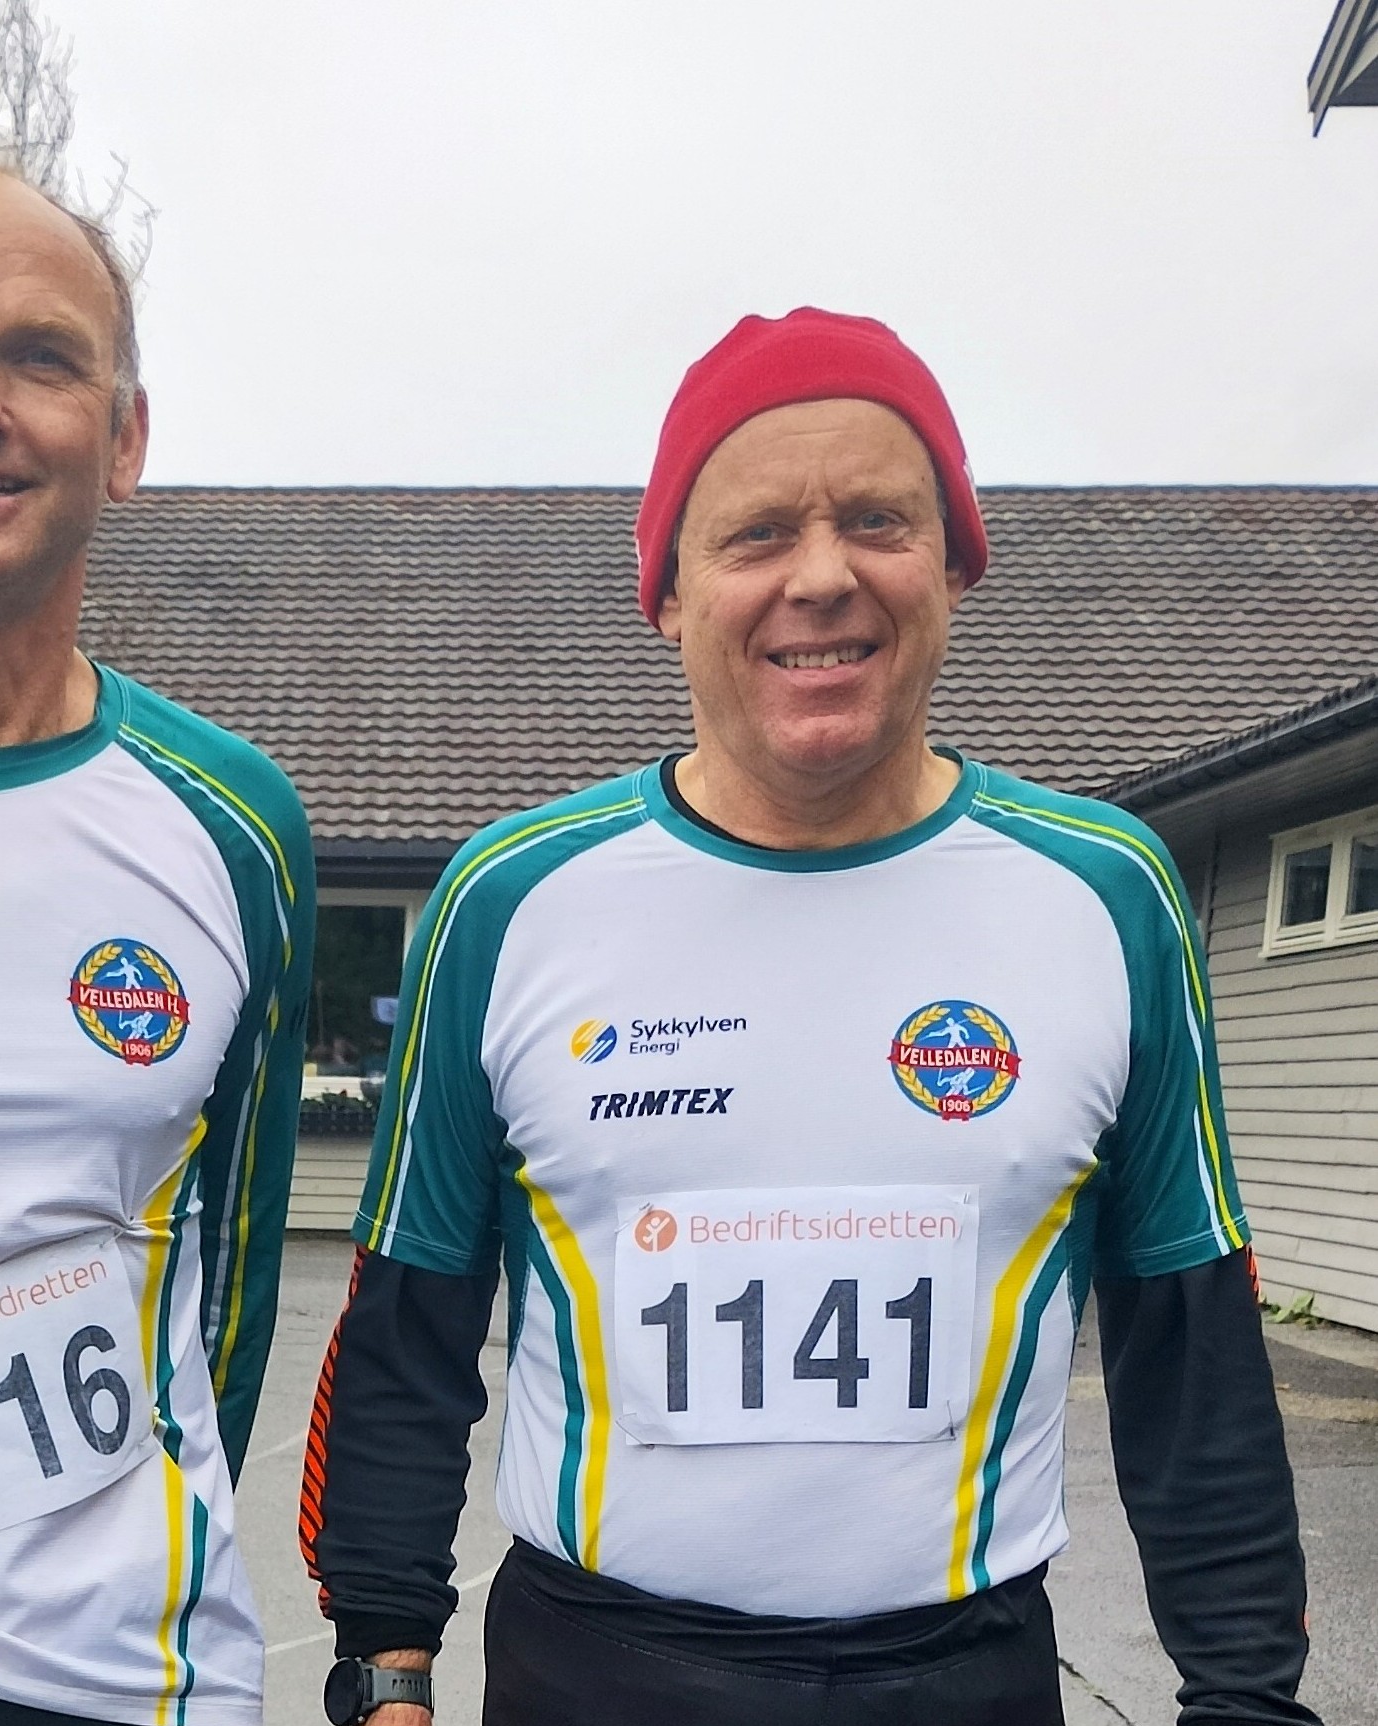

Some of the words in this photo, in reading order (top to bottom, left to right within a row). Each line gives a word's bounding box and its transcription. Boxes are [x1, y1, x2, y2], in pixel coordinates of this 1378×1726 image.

[79, 986, 165, 1010] VELLEDALEN
[630, 1015, 747, 1042] Sykkylven
[124, 1043, 152, 1057] 1906
[629, 1038, 680, 1056] Energi
[900, 1045, 991, 1067] VELLEDALEN
[589, 1087, 734, 1121] TRIMTEX
[942, 1099, 971, 1113] 1906
[689, 1208, 957, 1243] Bedriftsidretten
[641, 1277, 933, 1413] 1141
